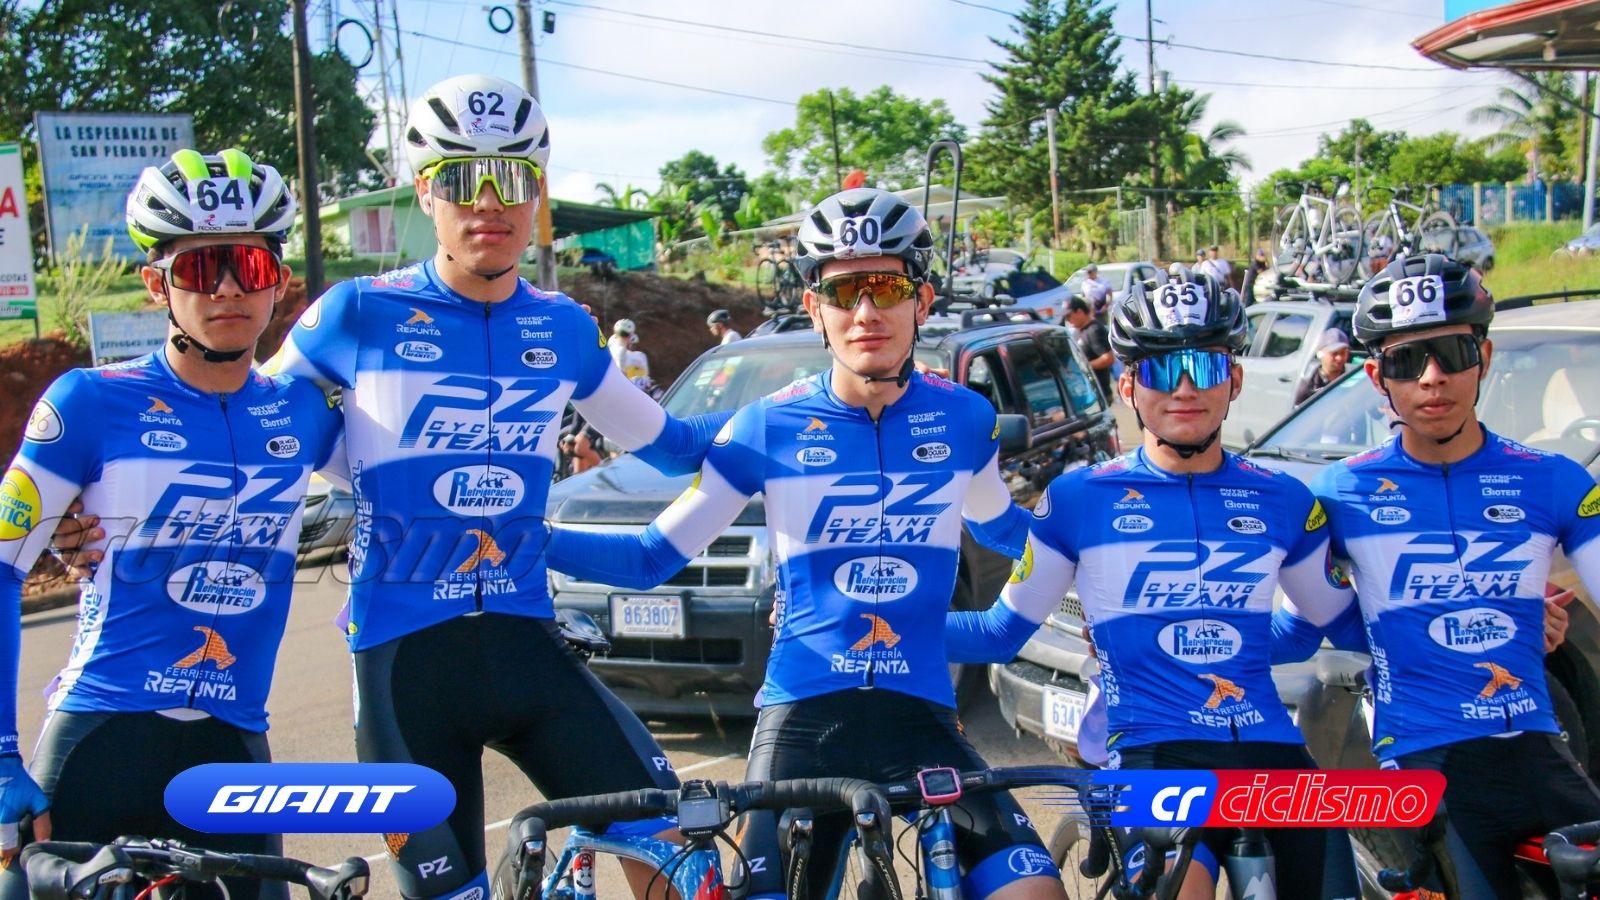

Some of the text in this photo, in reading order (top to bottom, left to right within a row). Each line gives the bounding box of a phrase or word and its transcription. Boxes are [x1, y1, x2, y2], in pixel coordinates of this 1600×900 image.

[468, 91, 505, 116] 62
[55, 125, 178, 140] LA ESPERANZA DE
[71, 145, 167, 157] SAN PEDRO PZ
[197, 179, 244, 211] 64
[840, 217, 879, 246] 60
[1160, 284, 1199, 308] 65
[1396, 277, 1437, 306] 66
[396, 323, 442, 336] REPUNTA
[521, 329, 553, 339] BIOTEST
[138, 412, 183, 426] REPUNTA
[398, 374, 561, 449] PZ
[260, 416, 292, 428] BIOTEST
[427, 420, 546, 435] CYCLING
[911, 425, 947, 436] BIOTEST
[424, 432, 540, 452] TEAM
[796, 432, 835, 441] REPUNTA
[138, 462, 304, 537] PZ
[1481, 487, 1522, 497] BIOTEST
[804, 471, 956, 544] PZ
[1113, 502, 1151, 510] REPUNTA
[1224, 499, 1260, 510] BIOTEST
[0, 502, 33, 532] TICA
[170, 510, 290, 526] CYCLING
[830, 516, 937, 528] CYCLING
[168, 522, 282, 546] TEAM
[826, 527, 934, 543] TEAM
[1122, 541, 1272, 608] PZ
[1388, 531, 1534, 601] PZ
[1146, 582, 1256, 594] CYCLING
[1410, 572, 1521, 584] CYCLING
[433, 579, 518, 600] REPUNTA
[1408, 583, 1520, 600] TEAM
[1143, 592, 1250, 609] TEAM
[624, 605, 678, 626] 863807
[830, 653, 911, 674] REPUNTA
[143, 670, 237, 701] REPUNTA
[1460, 697, 1538, 719] REPUNTA
[1187, 709, 1265, 729] REPUNTA
[418, 855, 453, 879] PZ
